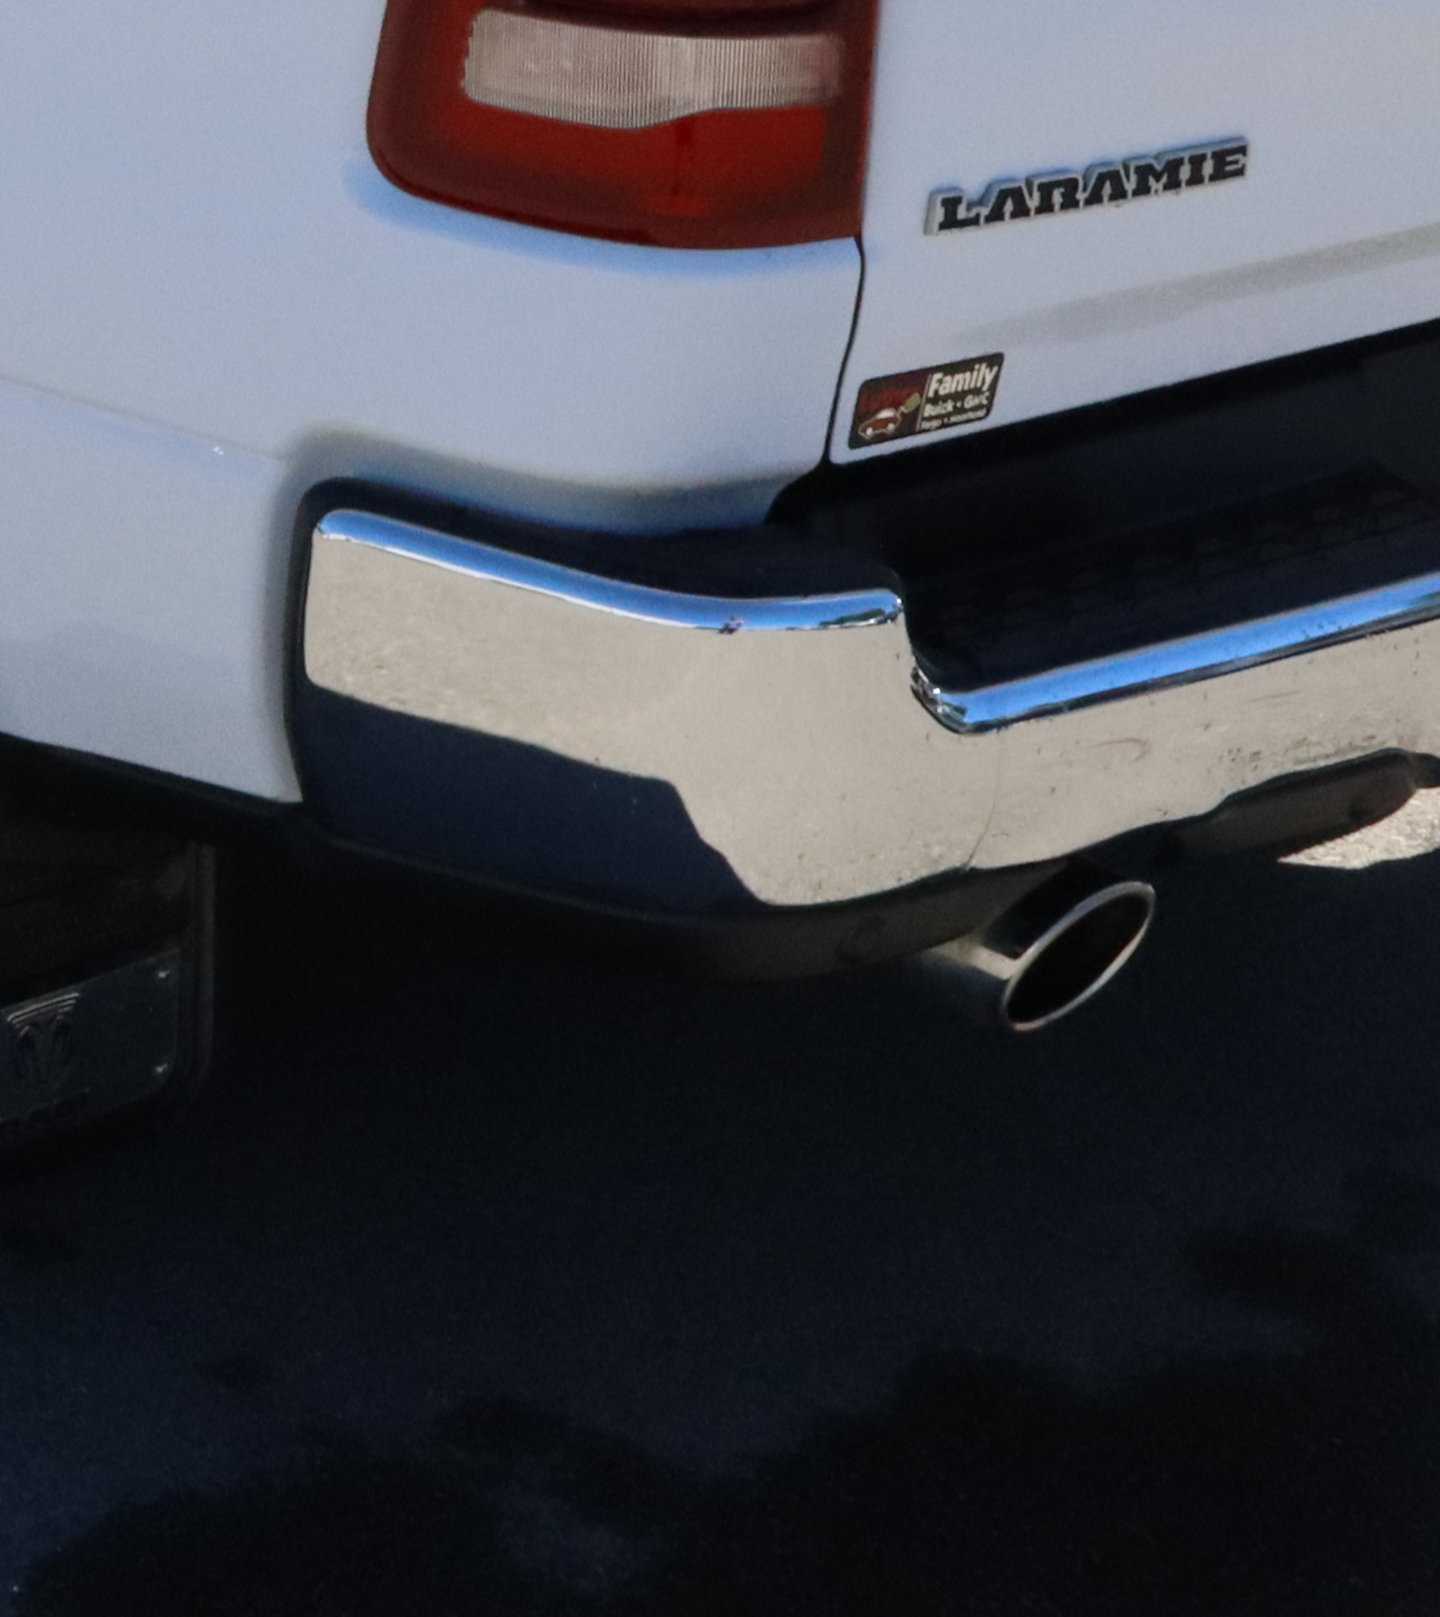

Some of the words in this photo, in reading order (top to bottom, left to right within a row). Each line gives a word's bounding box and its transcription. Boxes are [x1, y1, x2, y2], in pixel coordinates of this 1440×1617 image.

[925, 136, 1249, 235] LARAMIE
[928, 362, 999, 398] Family
[923, 399, 954, 417] Buick
[964, 391, 990, 408] GMC
